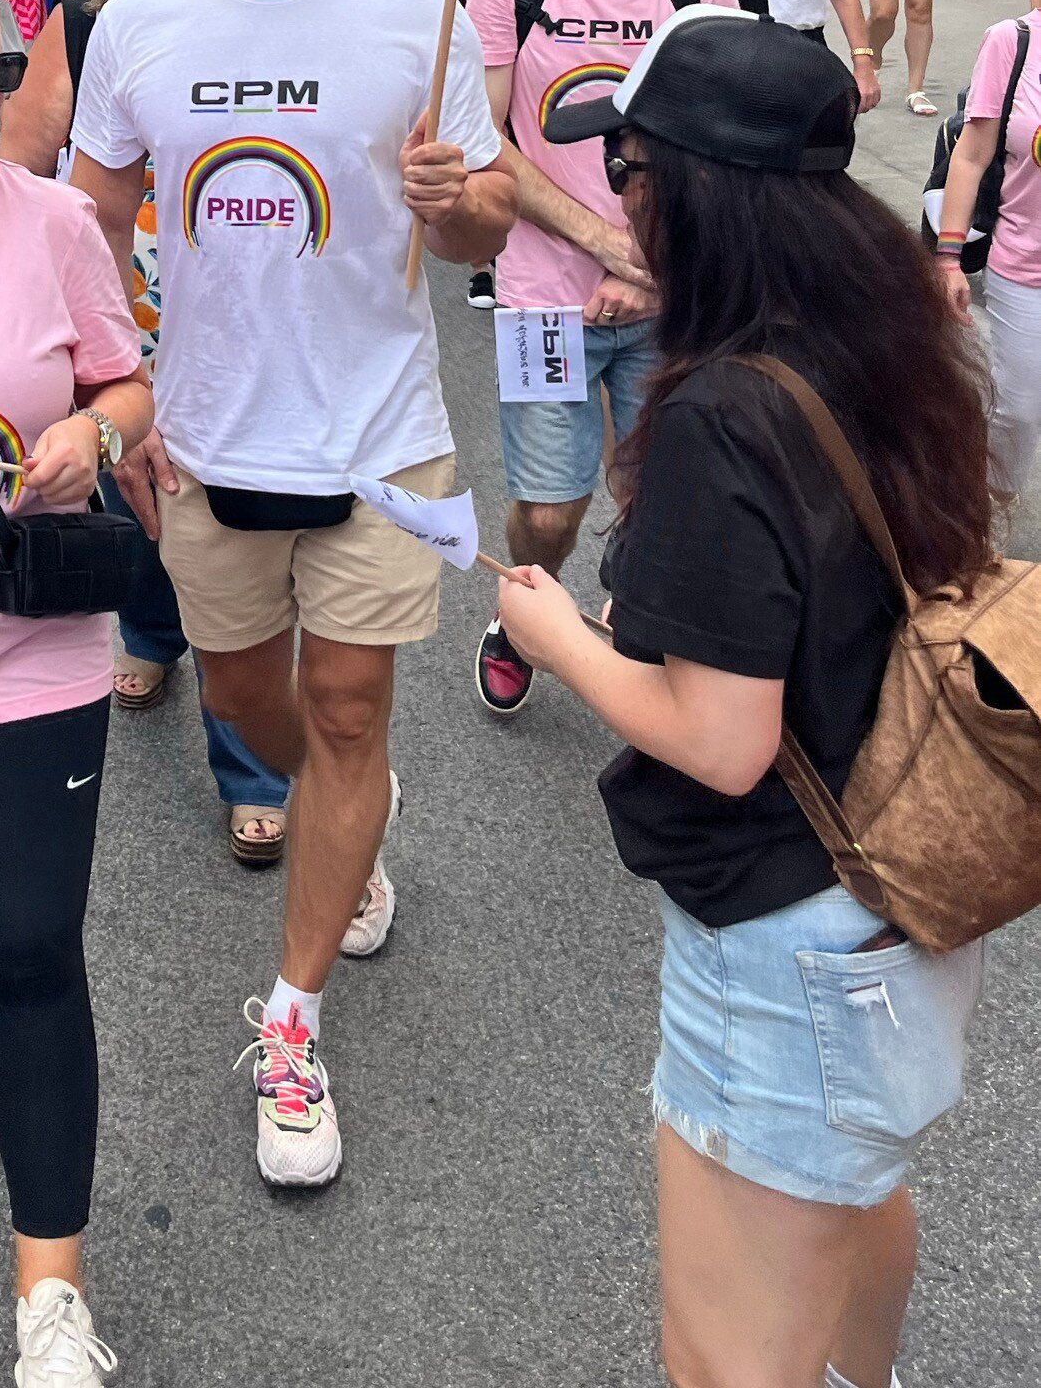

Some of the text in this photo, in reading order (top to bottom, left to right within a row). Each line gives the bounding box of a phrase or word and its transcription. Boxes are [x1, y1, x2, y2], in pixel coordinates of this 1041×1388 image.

[556, 18, 653, 40] CPM
[191, 80, 319, 105] CPM
[207, 197, 295, 222] PRIDE
